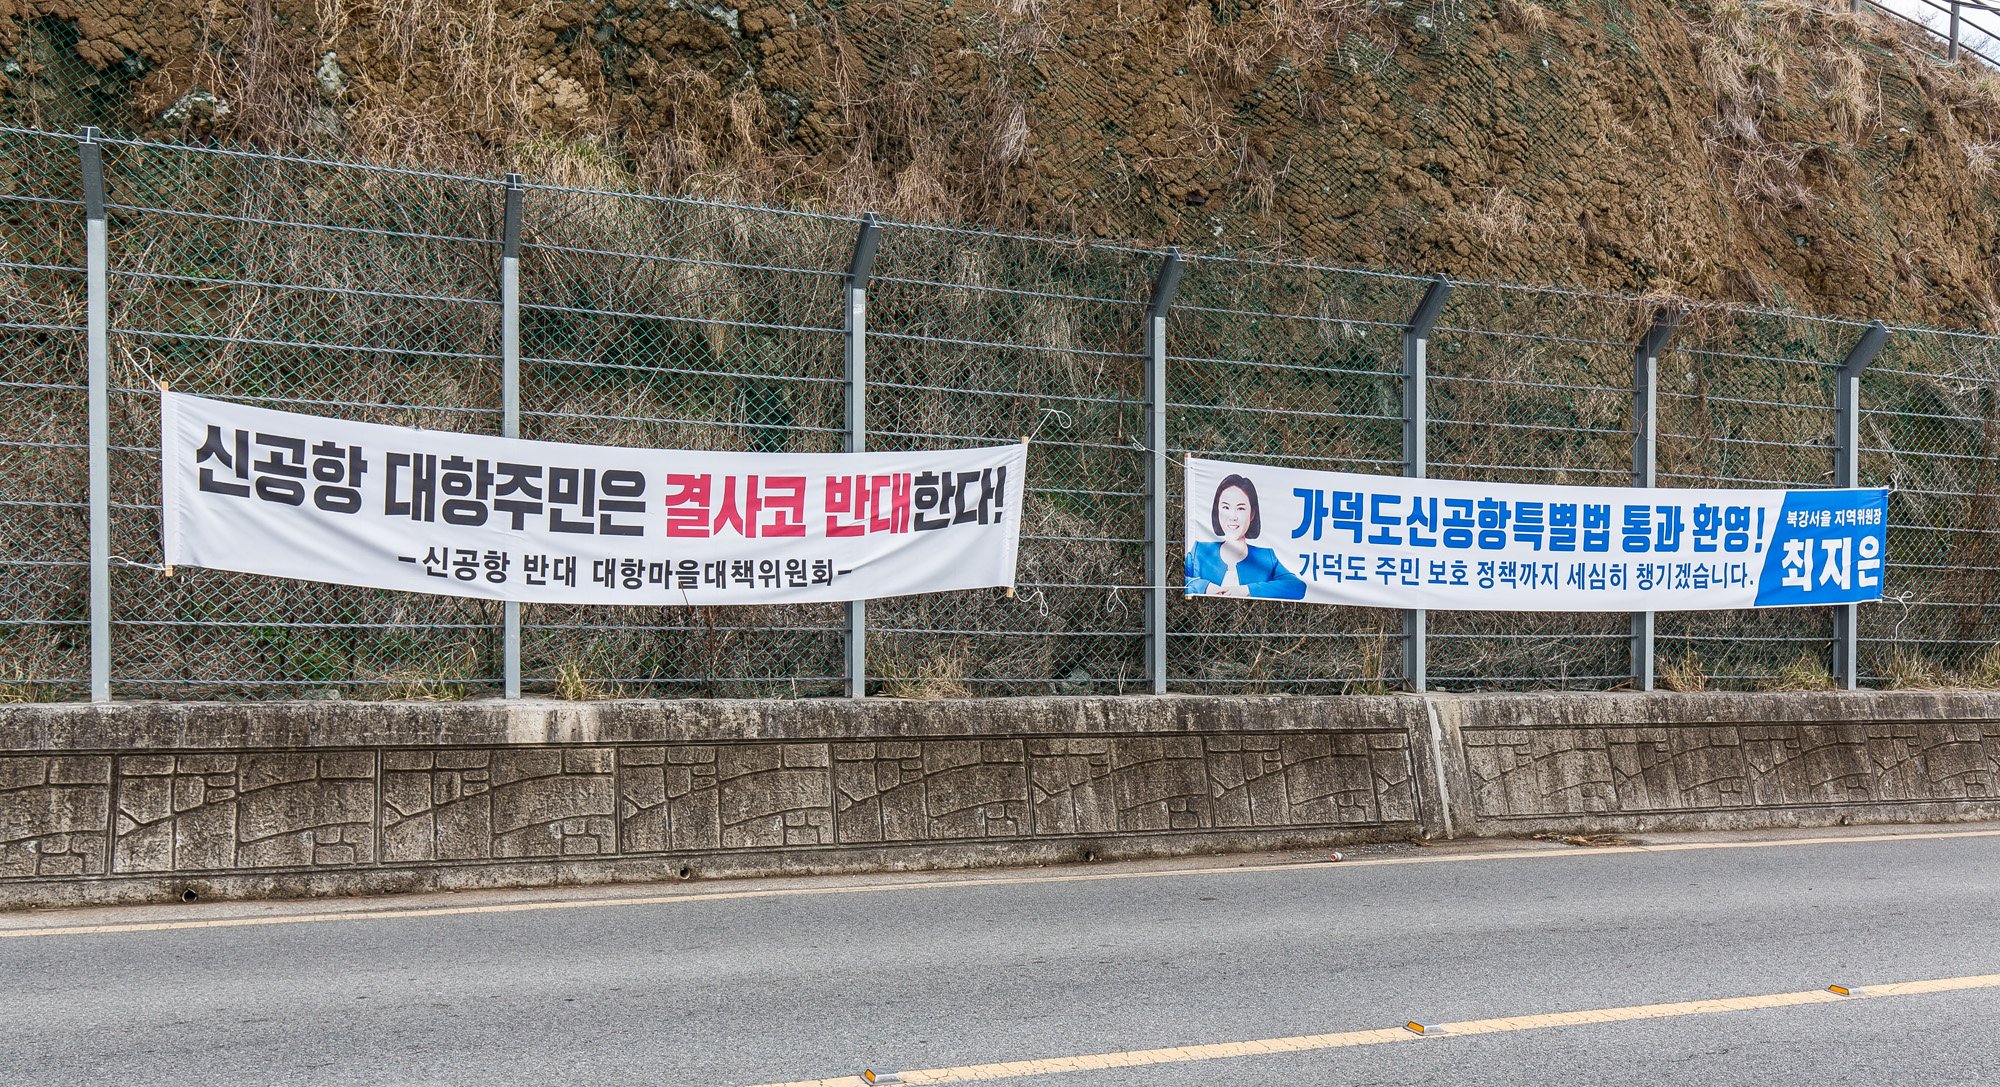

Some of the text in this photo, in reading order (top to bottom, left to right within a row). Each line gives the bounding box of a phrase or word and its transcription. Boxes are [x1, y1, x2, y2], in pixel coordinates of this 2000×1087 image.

[196, 424, 1007, 539] 신공항 대항주민은 결사코 반대한다!
[1291, 487, 1766, 553] 가덕도신공항특별법 통과 환영!
[1786, 508, 1883, 528] 북강서을 지역위원장
[523, 554, 577, 588] 반대
[1299, 552, 1755, 591] 가덕도 주민 보호 정책까지 세심히 챙기겠습니다.
[1781, 535, 1881, 592] 최지은
